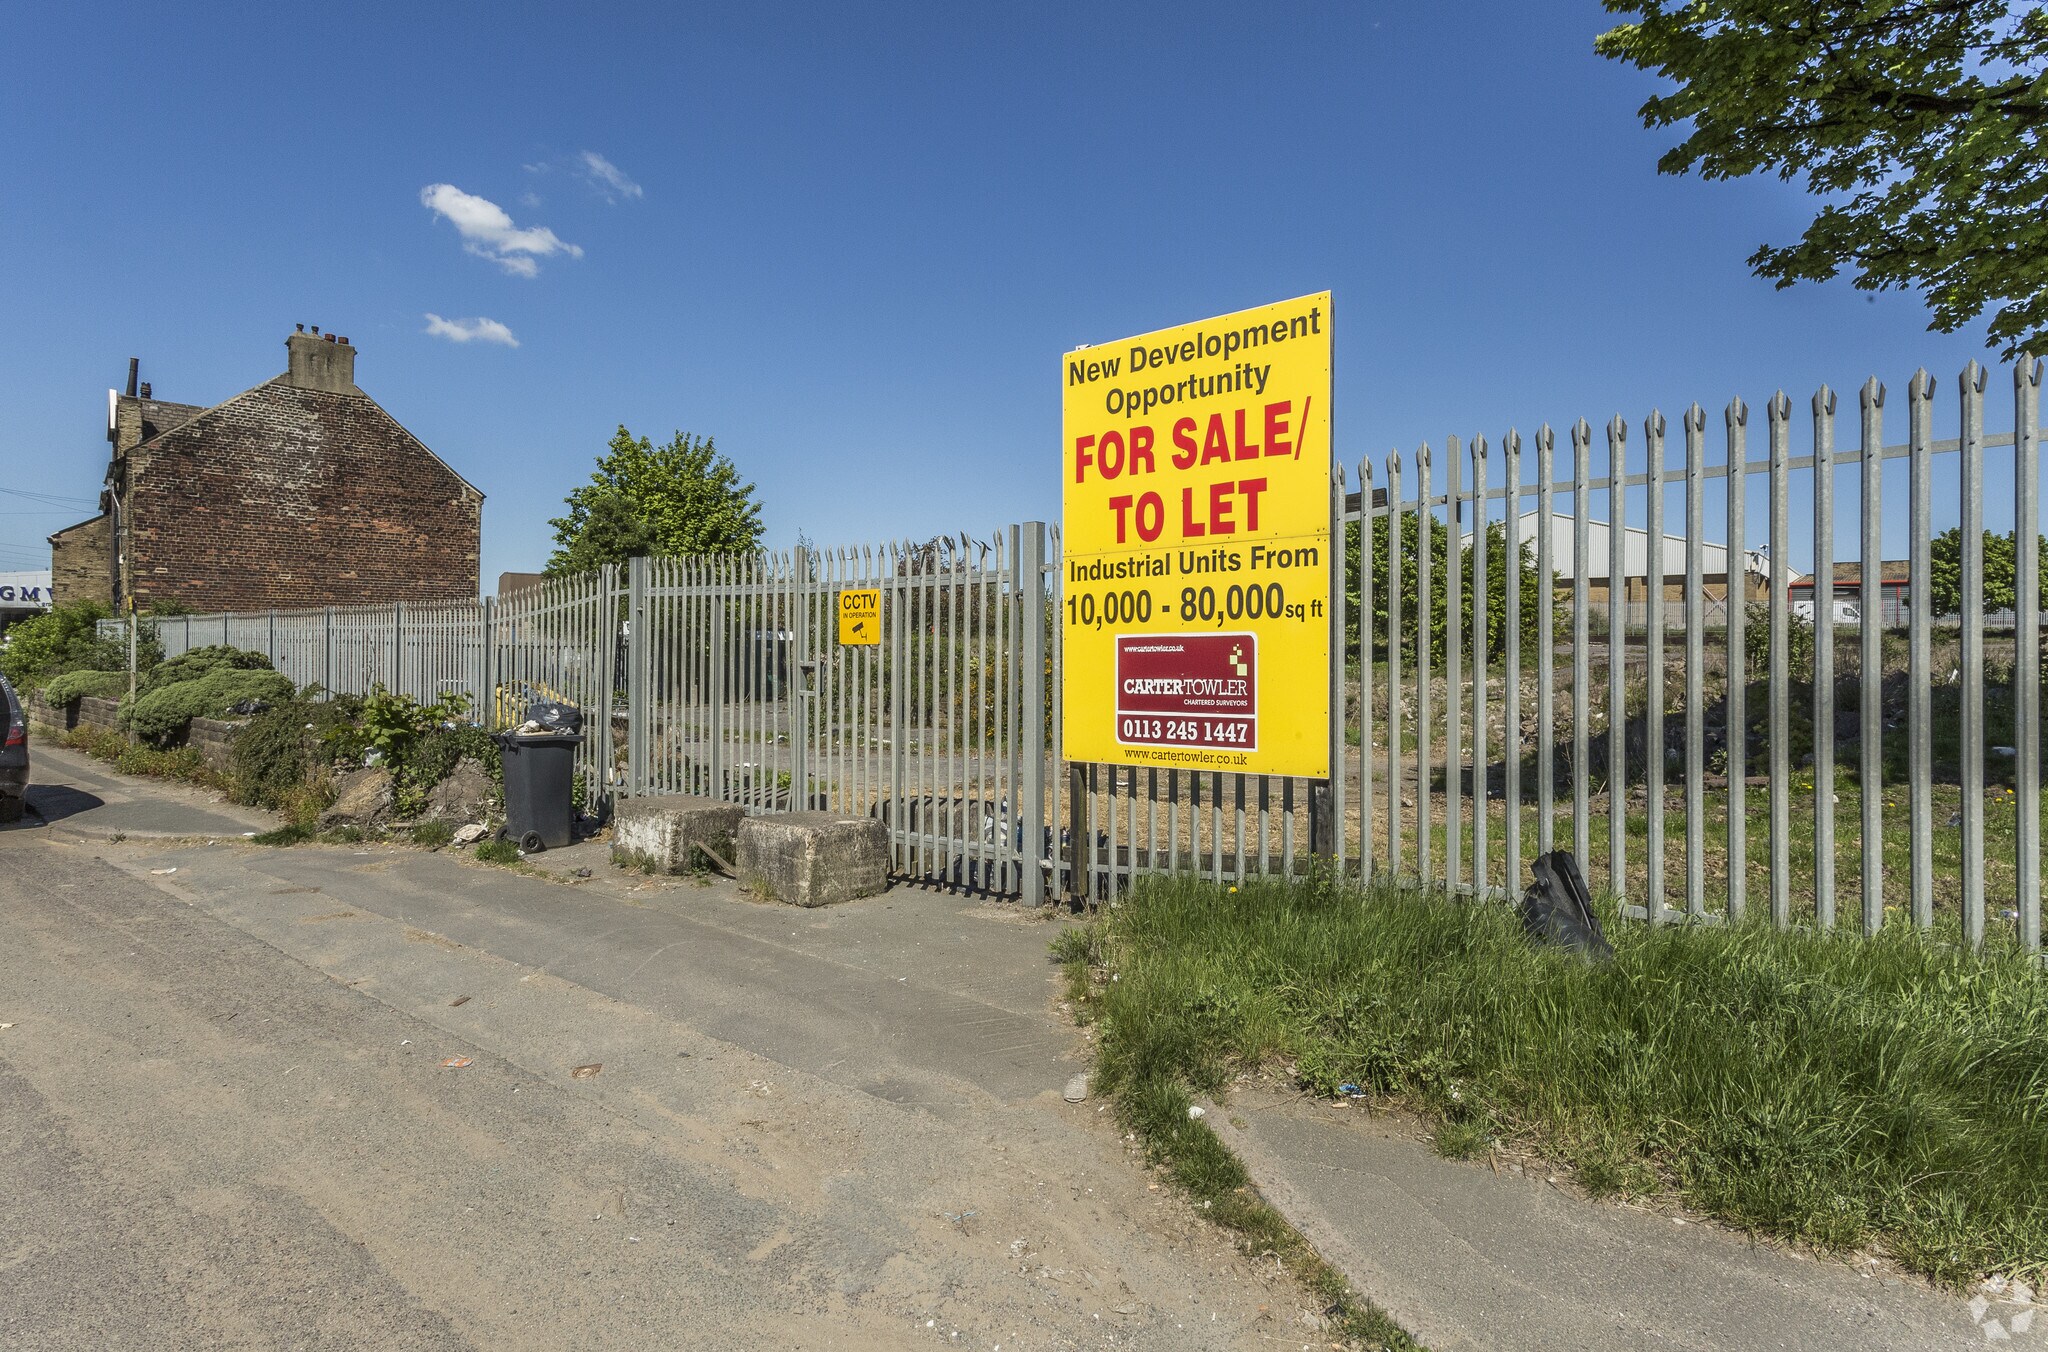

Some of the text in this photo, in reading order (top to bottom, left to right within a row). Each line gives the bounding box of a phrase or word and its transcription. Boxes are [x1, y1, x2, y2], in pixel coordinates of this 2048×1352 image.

[1069, 307, 1321, 386] New Development
[1106, 363, 1271, 418] Opportunity
[1076, 396, 1312, 483] FOR SALE/
[1109, 477, 1267, 544] TO LET
[1070, 546, 1318, 582] Industrial Units From
[843, 593, 876, 609] CCTV
[1068, 589, 1152, 631] 10,000
[1162, 605, 1171, 613] -
[1310, 599, 1323, 618] ft
[1123, 644, 1185, 654] www.cartertowler.co.uk
[1183, 698, 1248, 707] CHARTERED SURVEYORS
[1123, 719, 1248, 743] 0113 245 1447
[1124, 748, 1248, 766] www.cartertowler.co.uk
